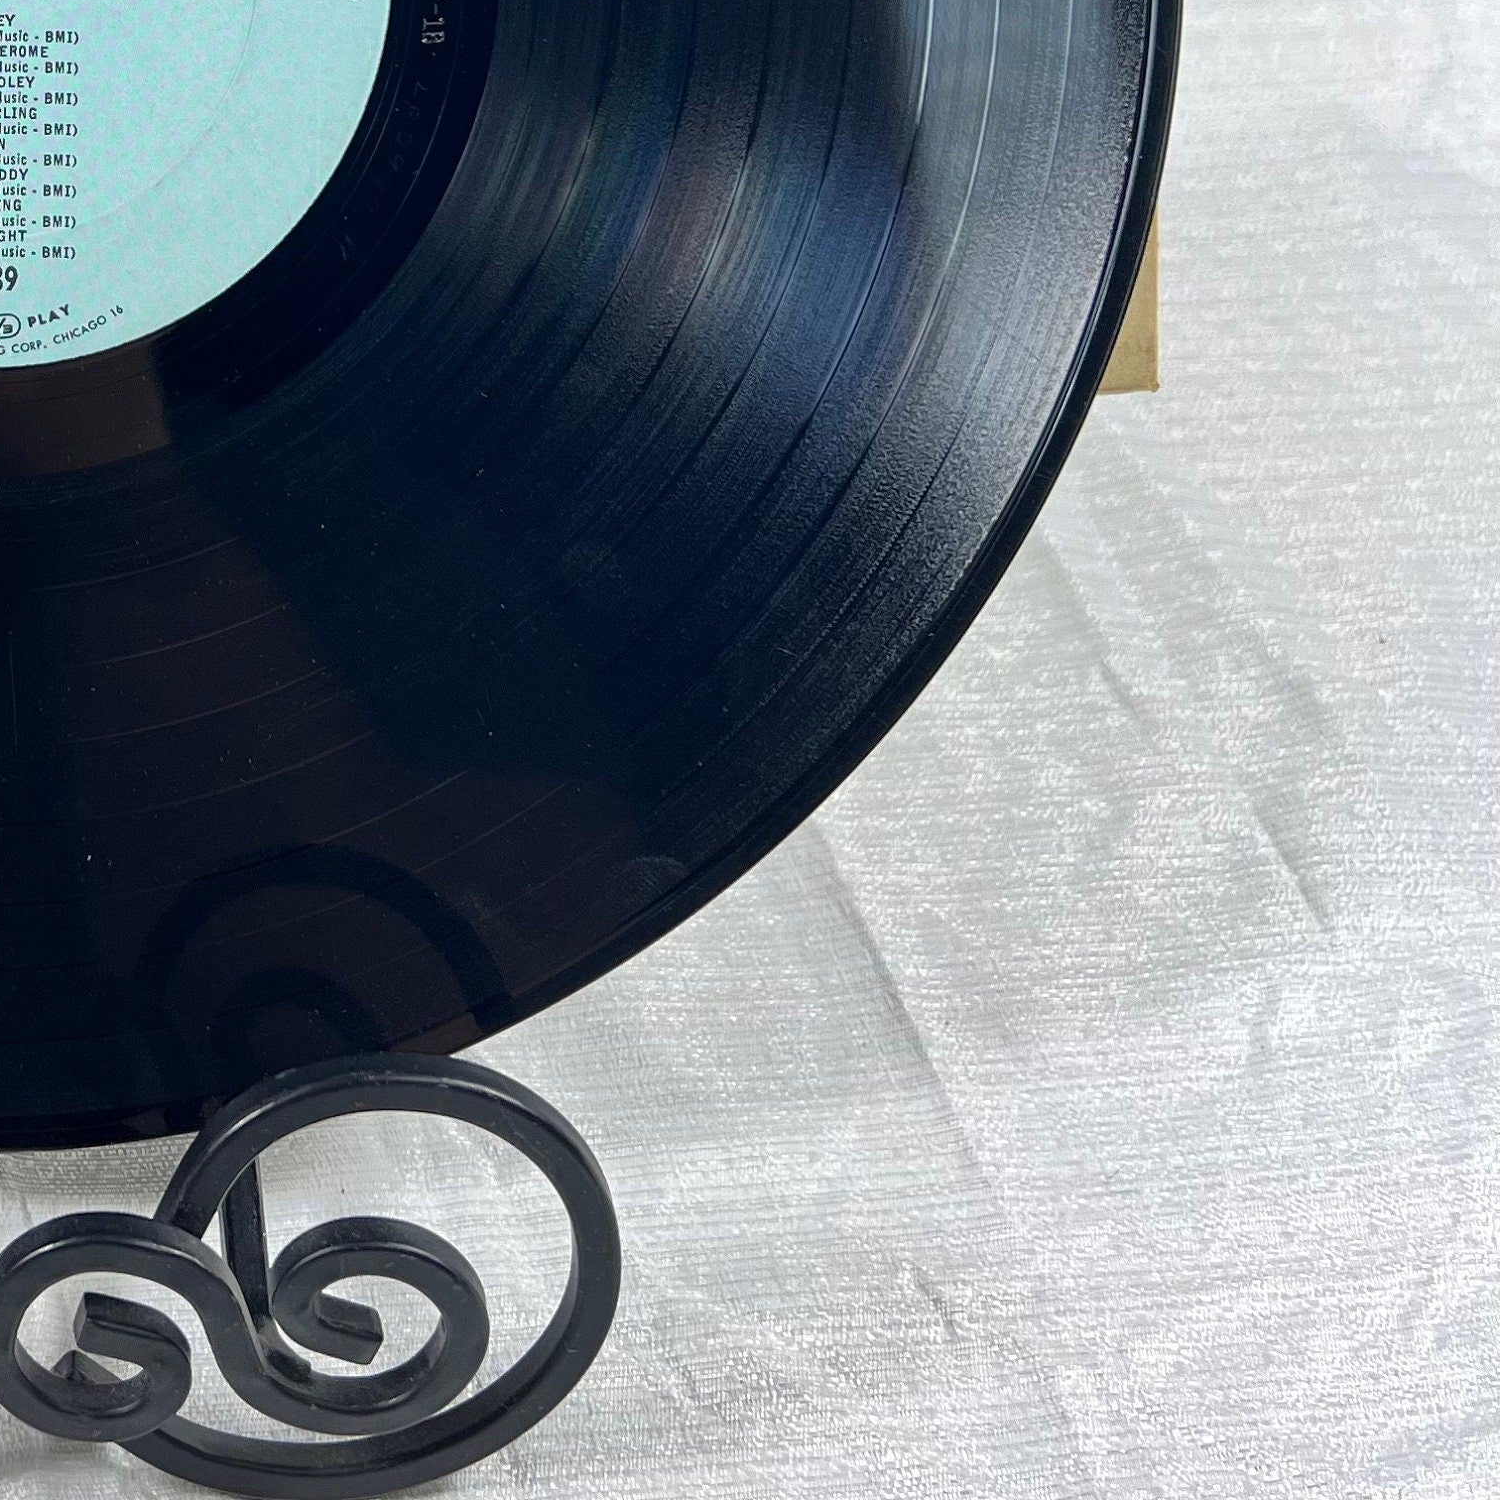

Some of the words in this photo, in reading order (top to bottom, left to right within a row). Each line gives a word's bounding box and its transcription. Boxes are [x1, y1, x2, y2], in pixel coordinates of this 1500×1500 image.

[45, 30, 79, 46] BMI)
[44, 61, 79, 76] BMI)
[44, 91, 79, 107] BMI)
[43, 122, 78, 137] BMI)
[43, 153, 77, 168] BMI)
[43, 183, 77, 199] BMI)
[42, 214, 77, 230] BMI)
[42, 245, 76, 260] BMI)
[27, 304, 70, 328] PLAY
[11, 340, 47, 353] CORP.
[52, 315, 107, 344] CHICAGO
[109, 305, 124, 318] 16
